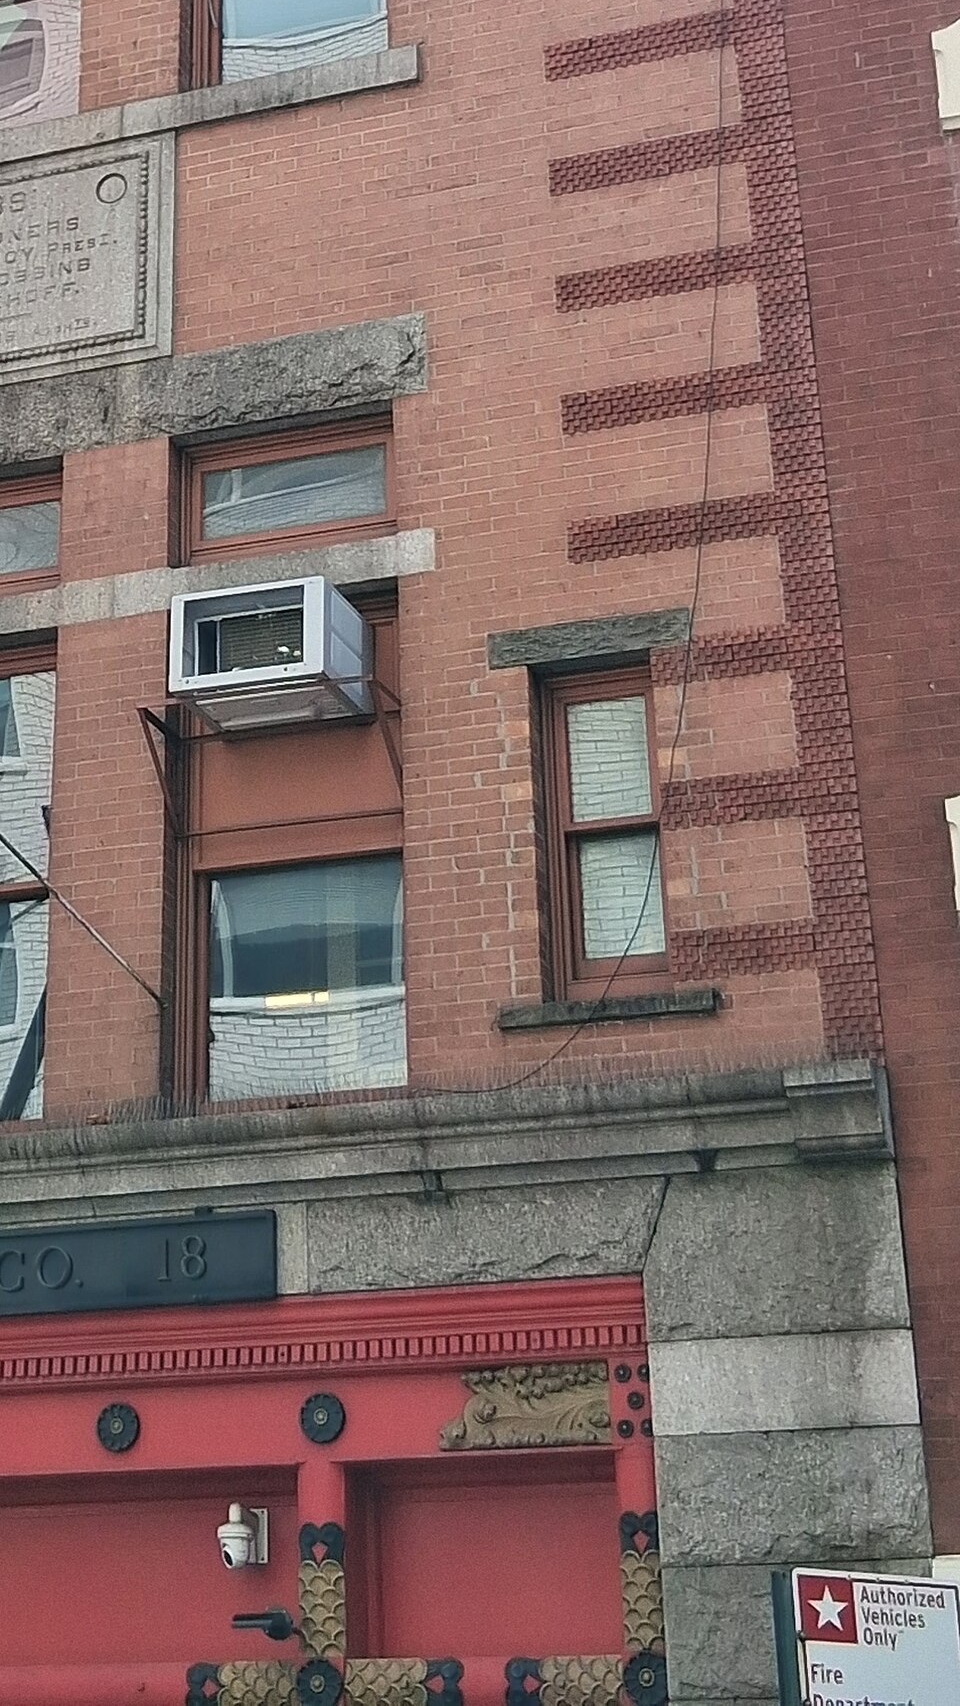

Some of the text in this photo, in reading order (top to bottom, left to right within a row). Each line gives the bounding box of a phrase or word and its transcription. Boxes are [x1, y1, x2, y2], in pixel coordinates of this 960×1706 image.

[157, 1233, 208, 1283] 18
[860, 1585, 946, 1609] Authorized
[861, 1606, 926, 1629] Vehicles
[863, 1627, 898, 1651] Only
[810, 1662, 844, 1685] Fire
